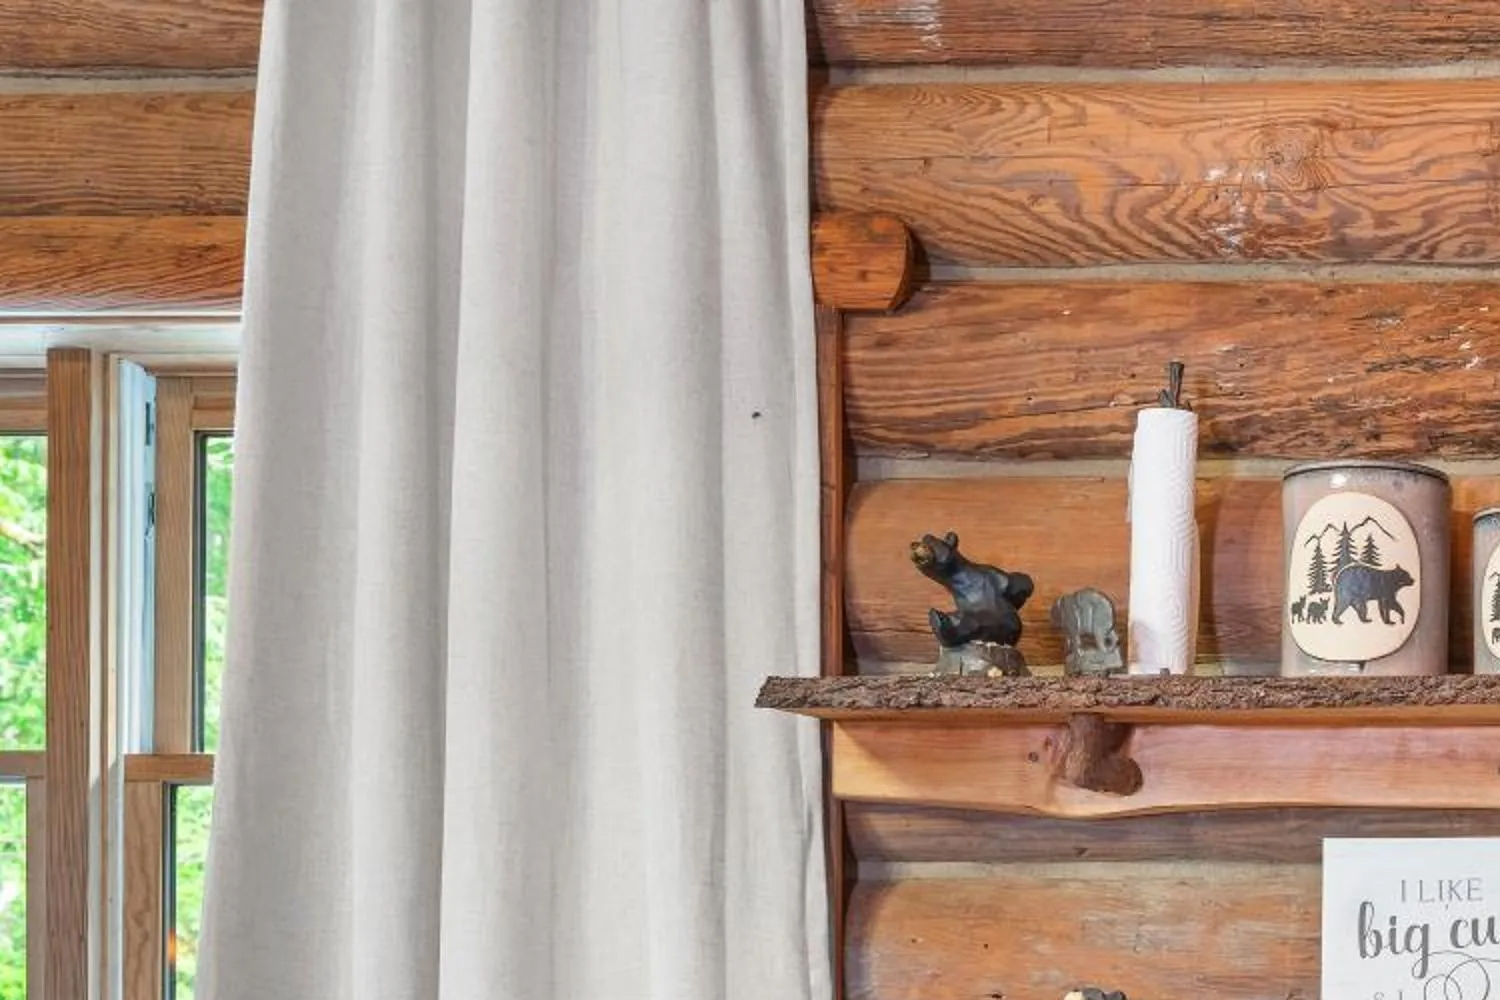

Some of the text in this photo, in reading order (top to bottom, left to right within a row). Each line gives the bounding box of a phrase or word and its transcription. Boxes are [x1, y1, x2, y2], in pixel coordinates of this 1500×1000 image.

[1401, 877, 1483, 903] I LIKE
[1357, 900, 1432, 980] big
